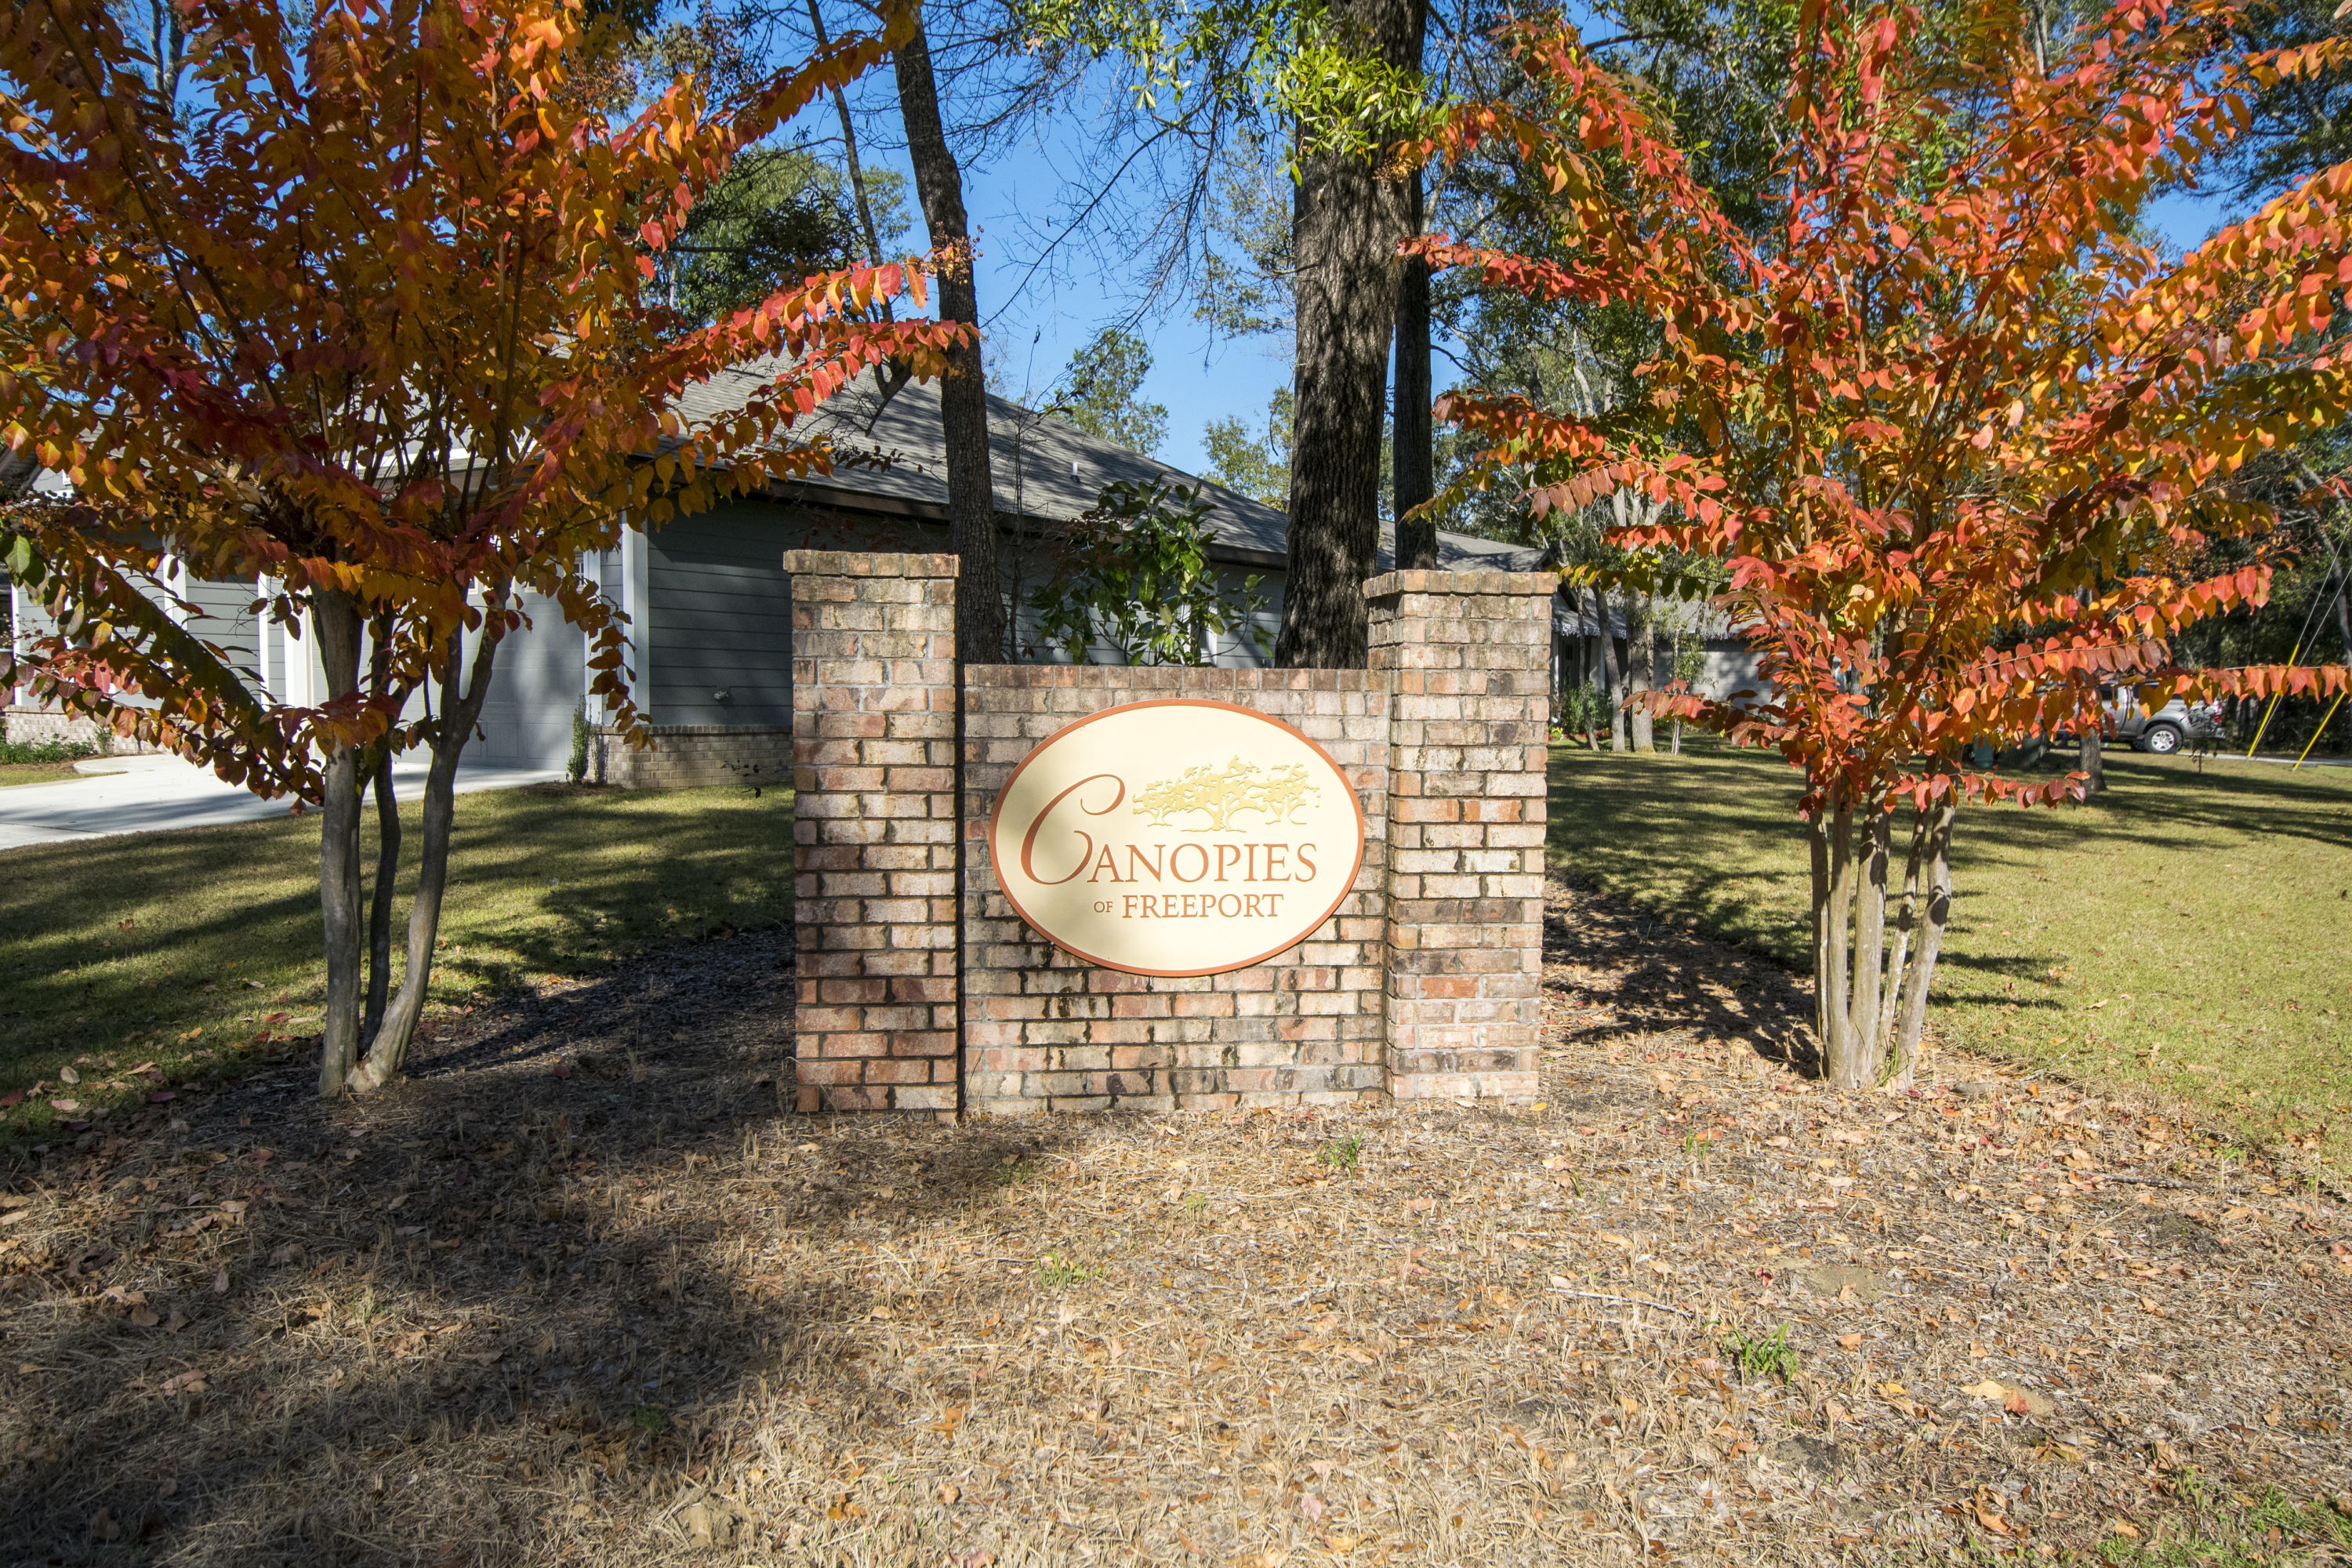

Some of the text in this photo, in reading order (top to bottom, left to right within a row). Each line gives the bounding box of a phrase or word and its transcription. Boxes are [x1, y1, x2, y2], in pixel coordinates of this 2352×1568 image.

[1021, 774, 1317, 884] CANOPIES
[1094, 894, 1283, 918] OF FREEPORT
